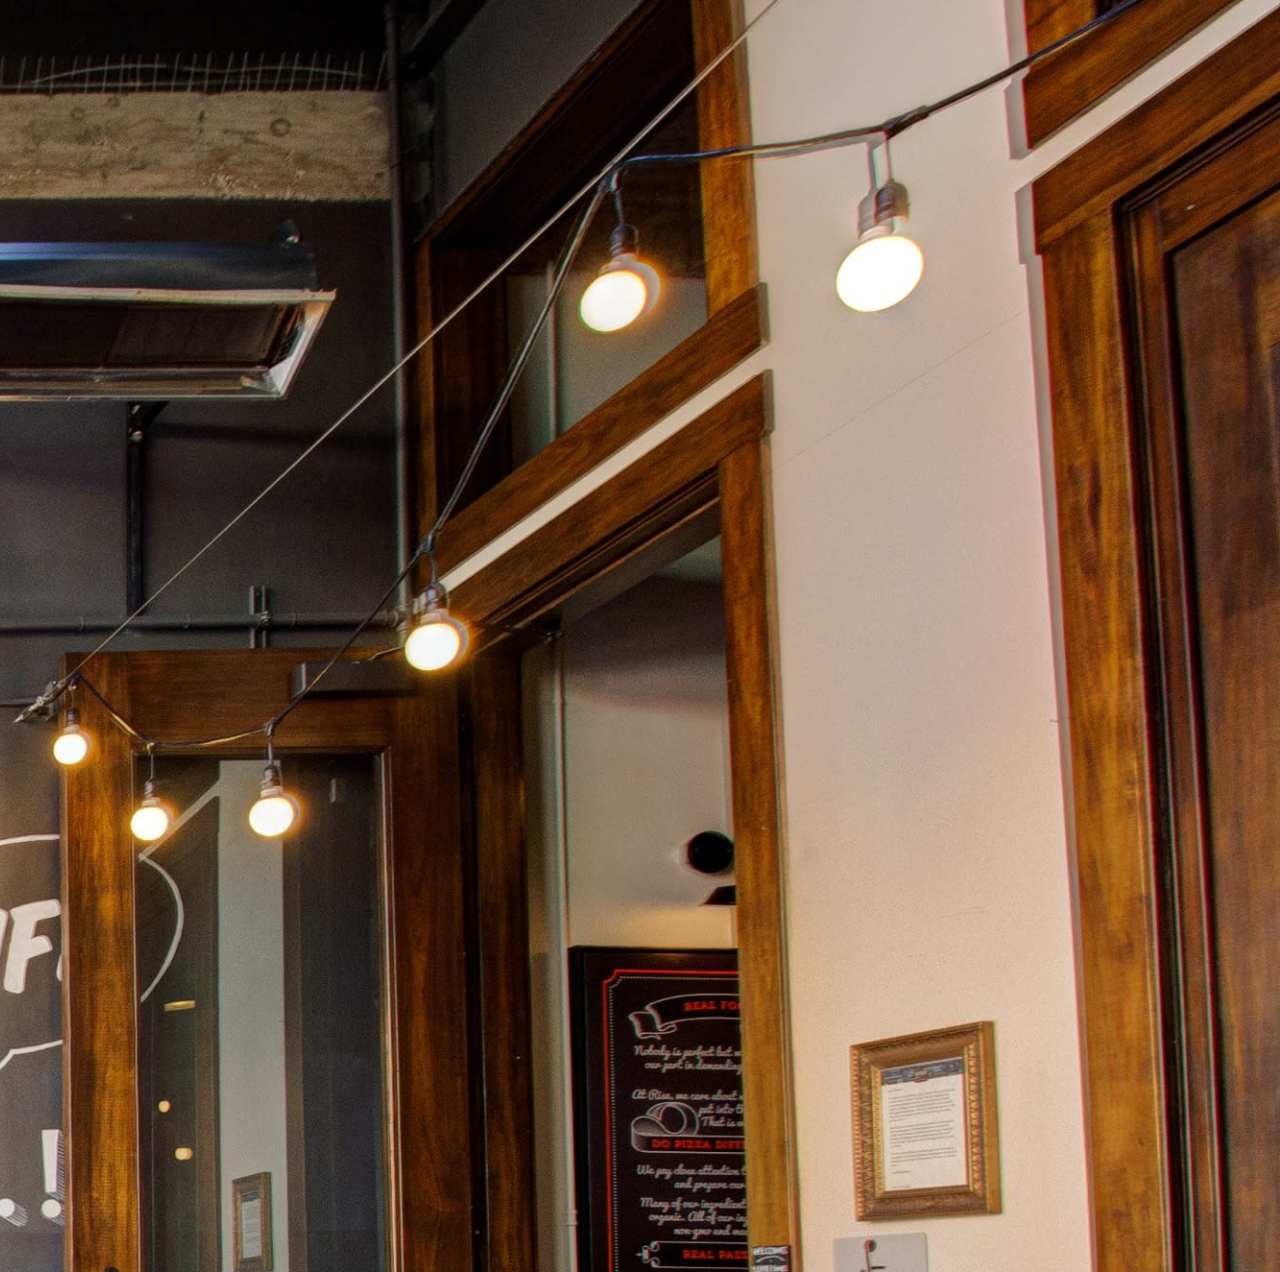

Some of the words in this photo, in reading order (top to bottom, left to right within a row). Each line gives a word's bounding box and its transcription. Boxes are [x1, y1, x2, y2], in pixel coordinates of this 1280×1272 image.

[634, 1045, 670, 1060] Nobody
[671, 1046, 682, 1056] is
[683, 1045, 715, 1060] perfect
[716, 1045, 733, 1056] but
[711, 1089, 739, 1100] about
[701, 1116, 725, 1127] That
[674, 1140, 711, 1149] PIZZA
[637, 1164, 652, 1175] We
[654, 1167, 672, 1180] pay
[674, 1177, 692, 1189] and
[640, 1197, 670, 1213] Many
[683, 1250, 715, 1259] REAL
